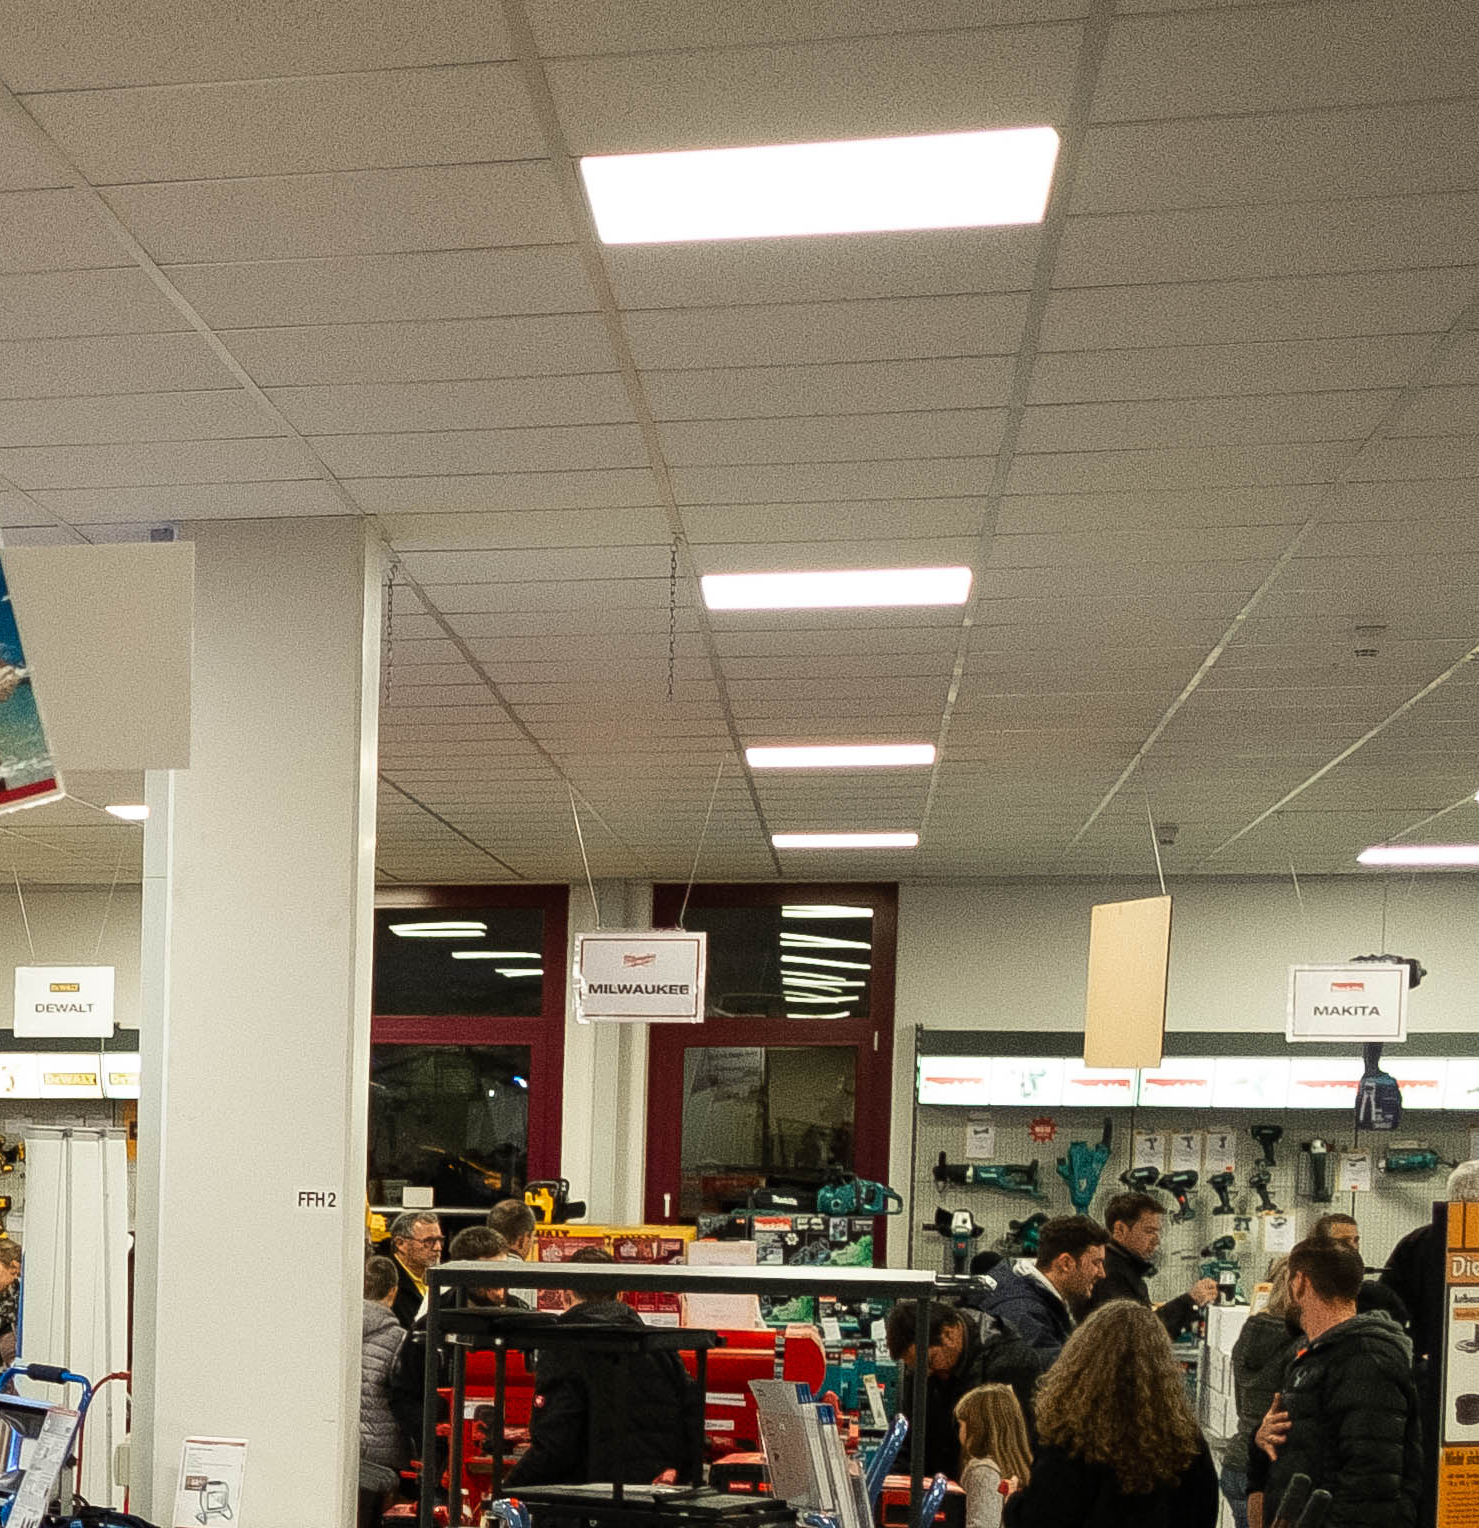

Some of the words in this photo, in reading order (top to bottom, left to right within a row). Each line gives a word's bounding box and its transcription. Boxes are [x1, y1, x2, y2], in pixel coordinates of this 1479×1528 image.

[588, 983, 690, 996] MILWAUKEE
[35, 1003, 94, 1013] DEWALT
[1313, 1005, 1381, 1017] MAKITA
[298, 1192, 326, 1208] FFH
[328, 1192, 336, 1208] 2
